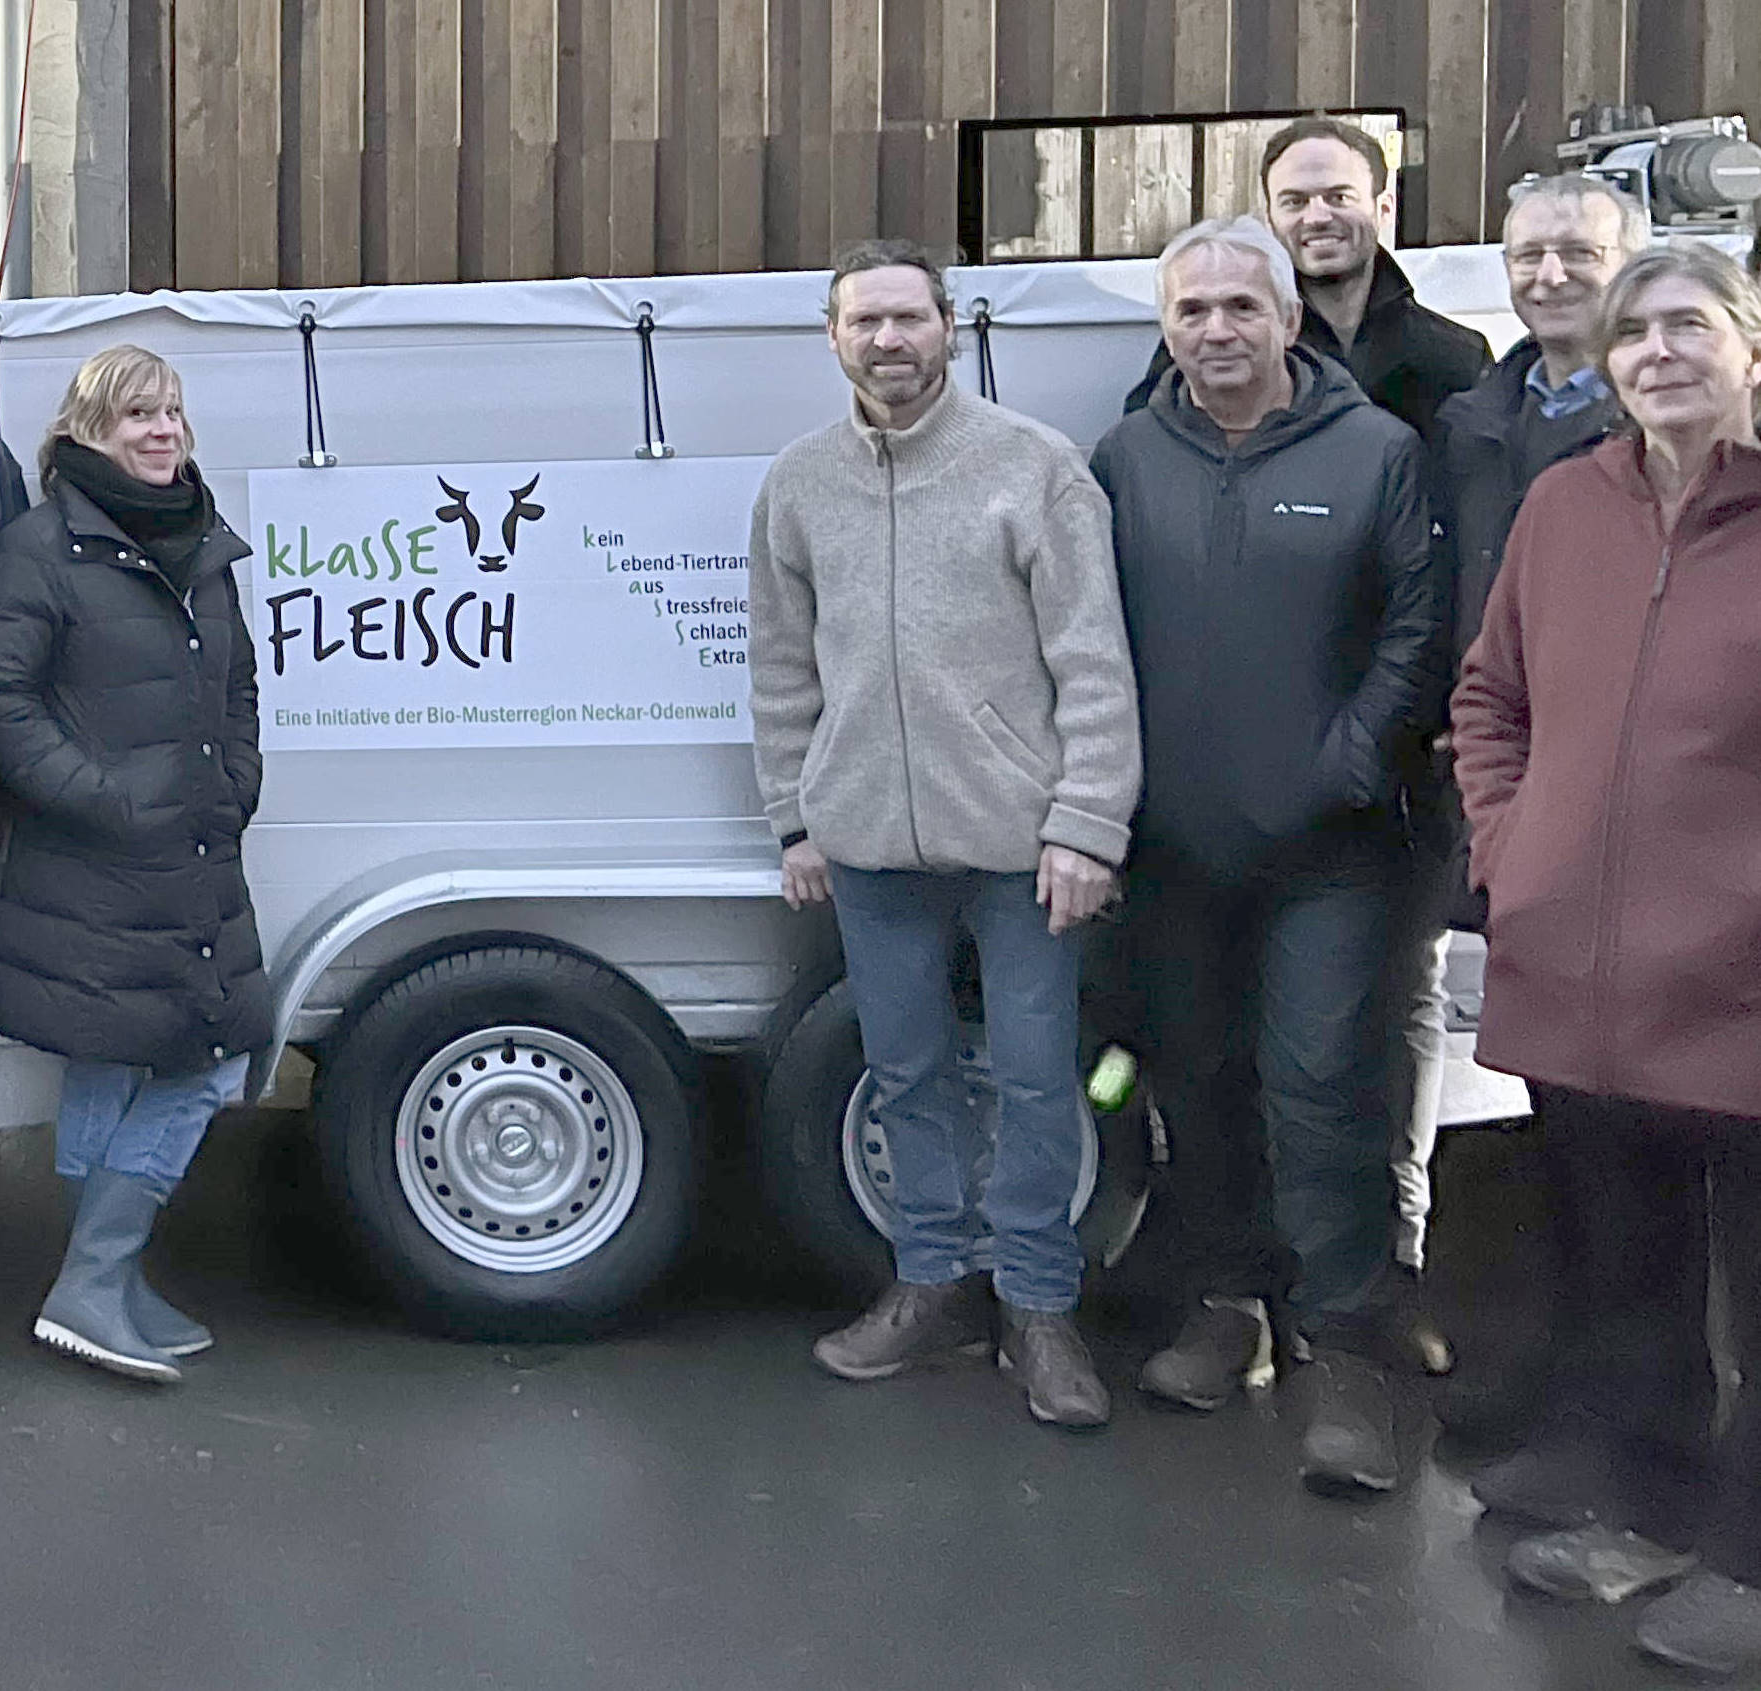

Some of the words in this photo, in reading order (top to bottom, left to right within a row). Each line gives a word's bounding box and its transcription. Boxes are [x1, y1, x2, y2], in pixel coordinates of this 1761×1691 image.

[629, 579, 664, 595] aus
[266, 587, 515, 676] FLEISCH
[699, 647, 746, 668] Extra
[275, 708, 312, 726] Eine
[316, 706, 390, 726] Initiative
[394, 706, 423, 725] der
[427, 703, 577, 726] Bio-Musterregion
[582, 701, 737, 722] Neckar-Odenwald
